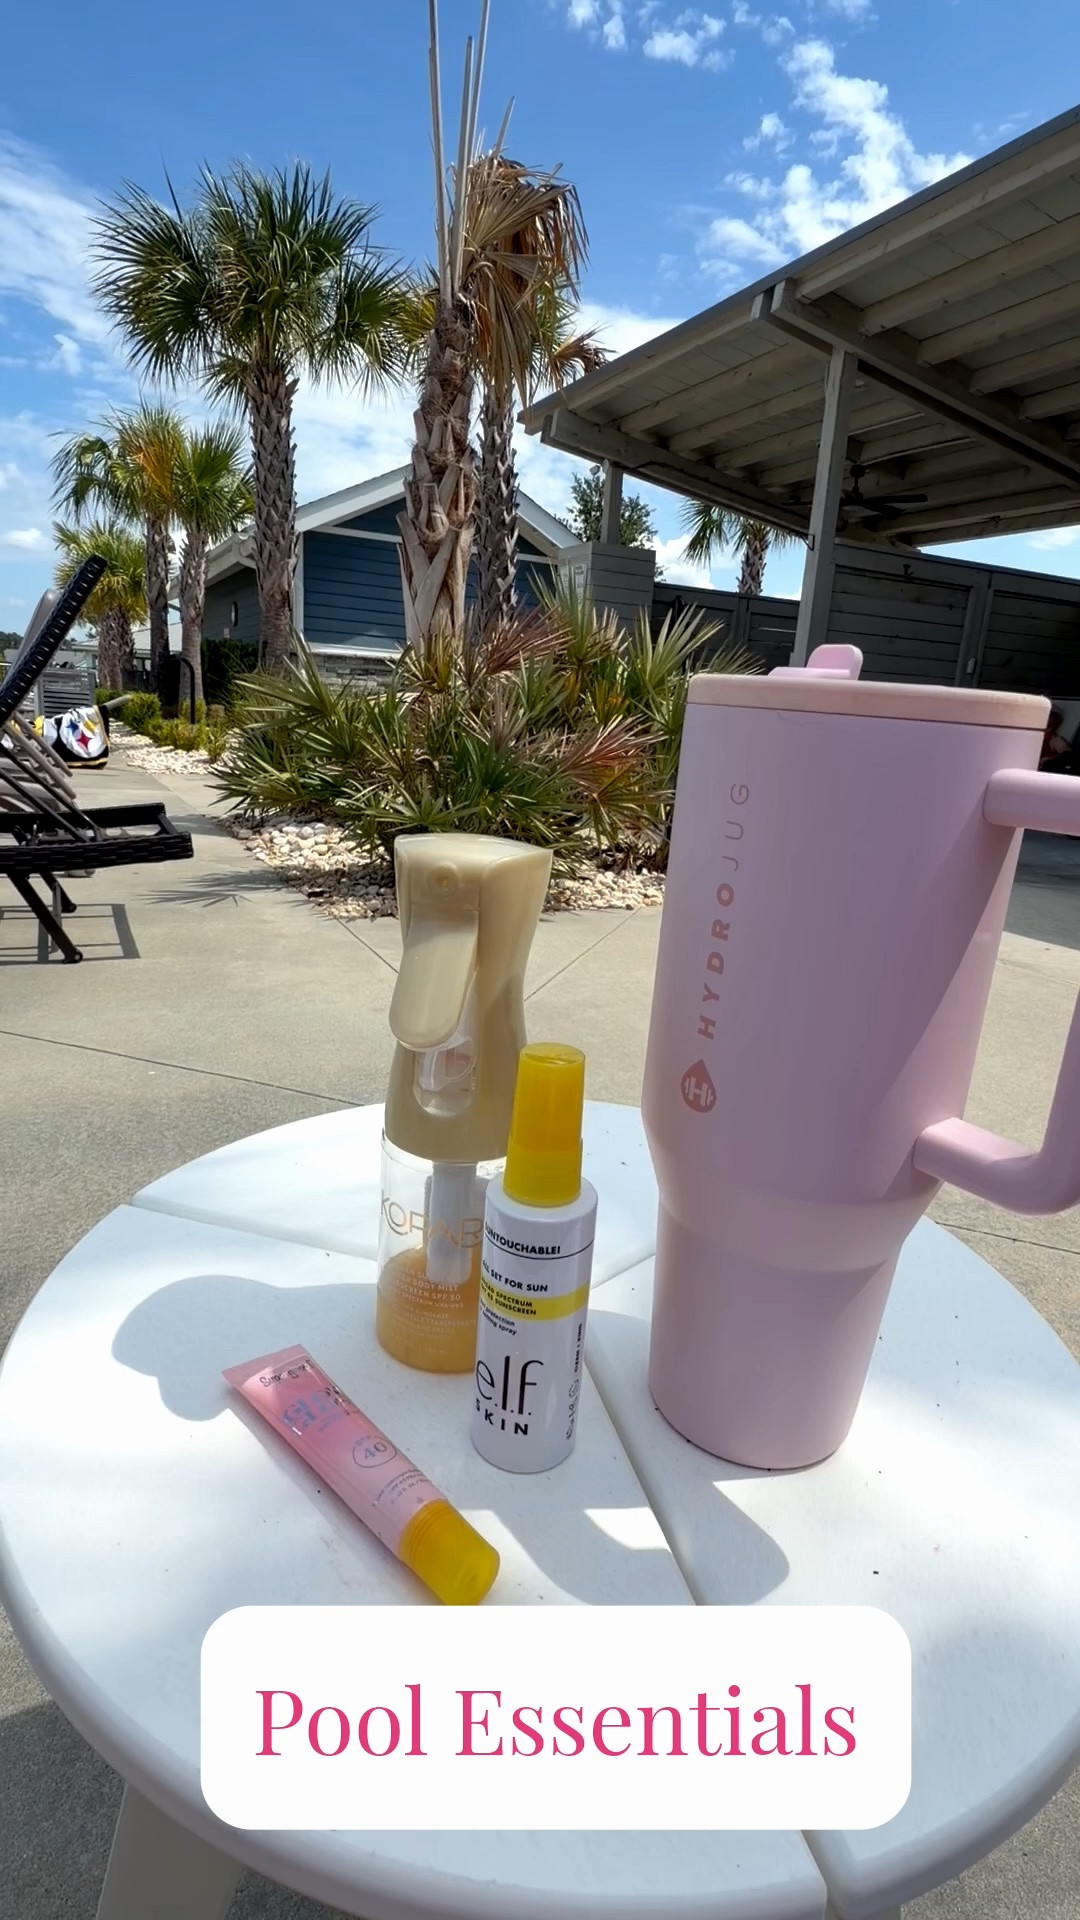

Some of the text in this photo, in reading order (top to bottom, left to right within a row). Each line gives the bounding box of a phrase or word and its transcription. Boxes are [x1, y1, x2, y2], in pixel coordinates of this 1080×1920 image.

[697, 783, 750, 1041] HYDROJUG
[490, 1269, 503, 1282] SET
[504, 1277, 523, 1291] FOR
[525, 1284, 548, 1292] SUN
[495, 1297, 537, 1316] SUNSCREEN
[496, 1290, 533, 1308] SPECTRUM
[475, 1398, 529, 1435] SKIN
[364, 1442, 388, 1460] 40
